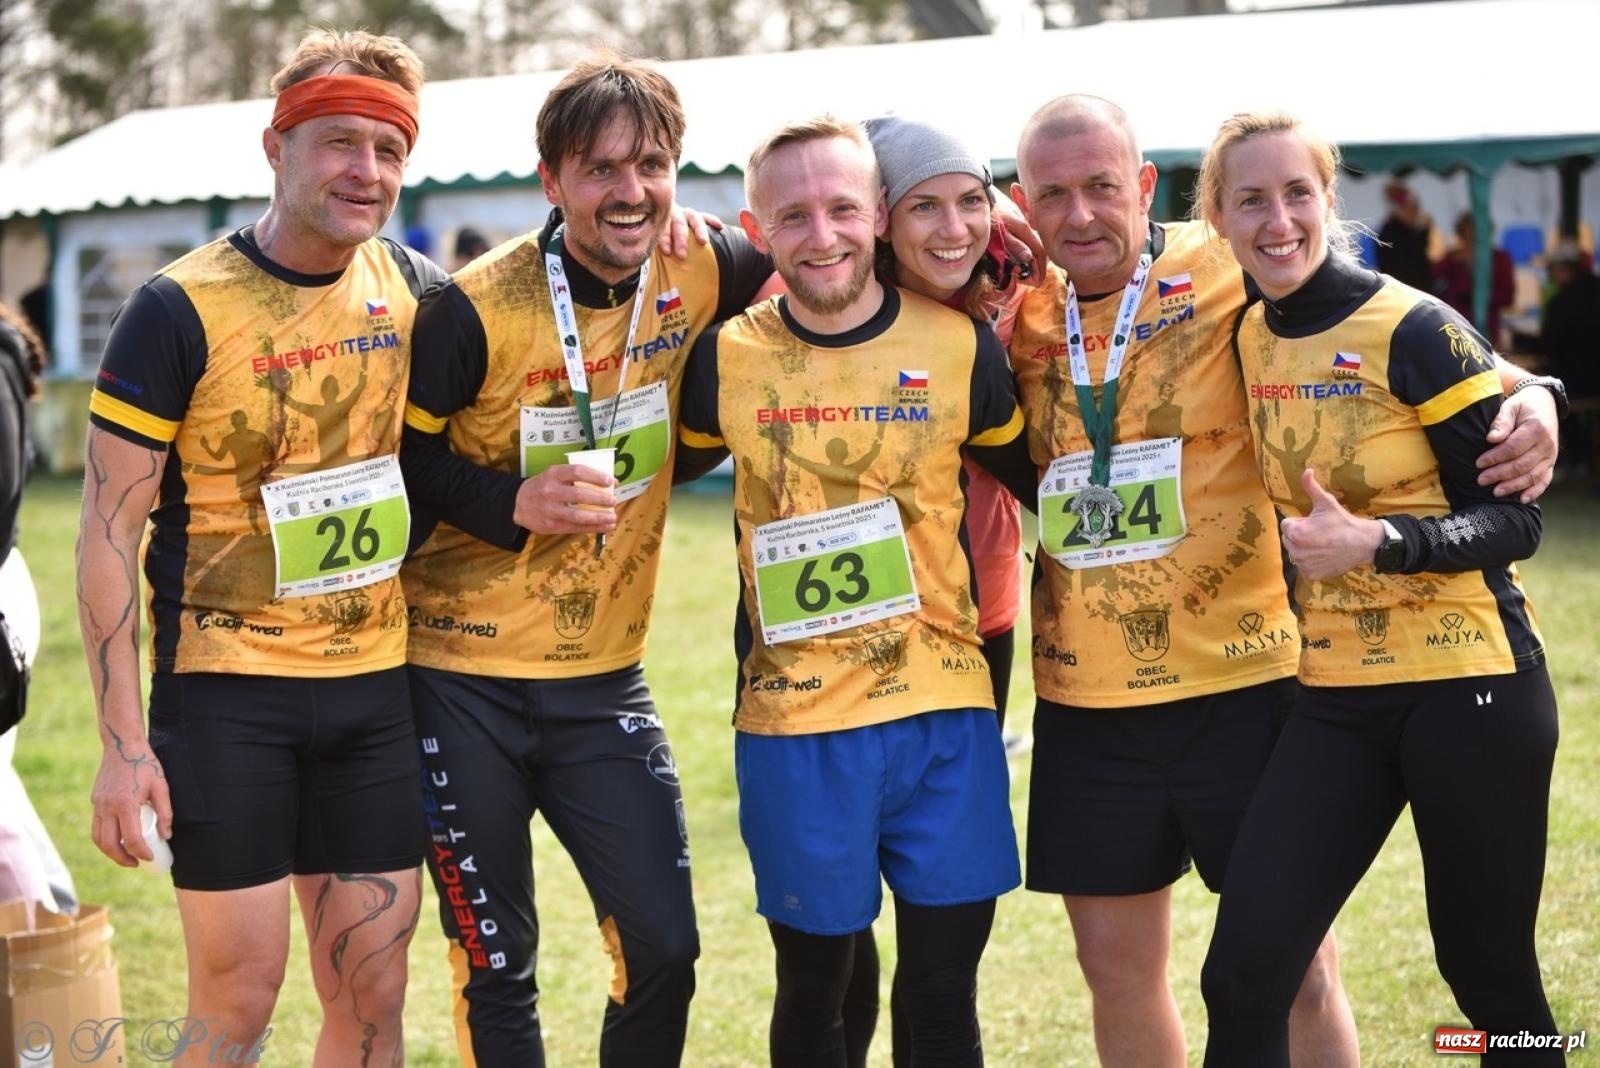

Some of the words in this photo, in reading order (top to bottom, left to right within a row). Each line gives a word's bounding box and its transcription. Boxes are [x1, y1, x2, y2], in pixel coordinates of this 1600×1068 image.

[1160, 294, 1196, 306] CZECH
[630, 328, 690, 362] TEAM
[252, 341, 338, 374] ENERGY
[344, 332, 400, 354] TEAM
[1250, 384, 1296, 400] ENERGY
[1301, 382, 1362, 399] TEAM
[756, 407, 852, 424] ENERGY
[860, 406, 928, 422] TEAM
[1140, 442, 1170, 452] RAFAMET
[850, 502, 885, 516] RAFAMET
[856, 514, 872, 524] 2025
[316, 508, 380, 571] 26
[795, 552, 870, 612] 63
[330, 636, 352, 646] OBEC
[1224, 629, 1292, 658] MAJYA
[1426, 630, 1485, 647] MAJYA
[324, 646, 359, 657] BOLATICE
[556, 642, 583, 652] OBEC
[544, 652, 590, 662] BOLATICE
[941, 657, 986, 671] MAJYA
[1362, 656, 1396, 666] BOLATICE
[1136, 664, 1166, 676] OBEC
[875, 676, 898, 688] OBEC
[1127, 674, 1180, 690] BOLATICE
[866, 682, 910, 700] BOLATICE
[422, 737, 506, 969] BOLATICE
[434, 845, 489, 968] ENERGY
